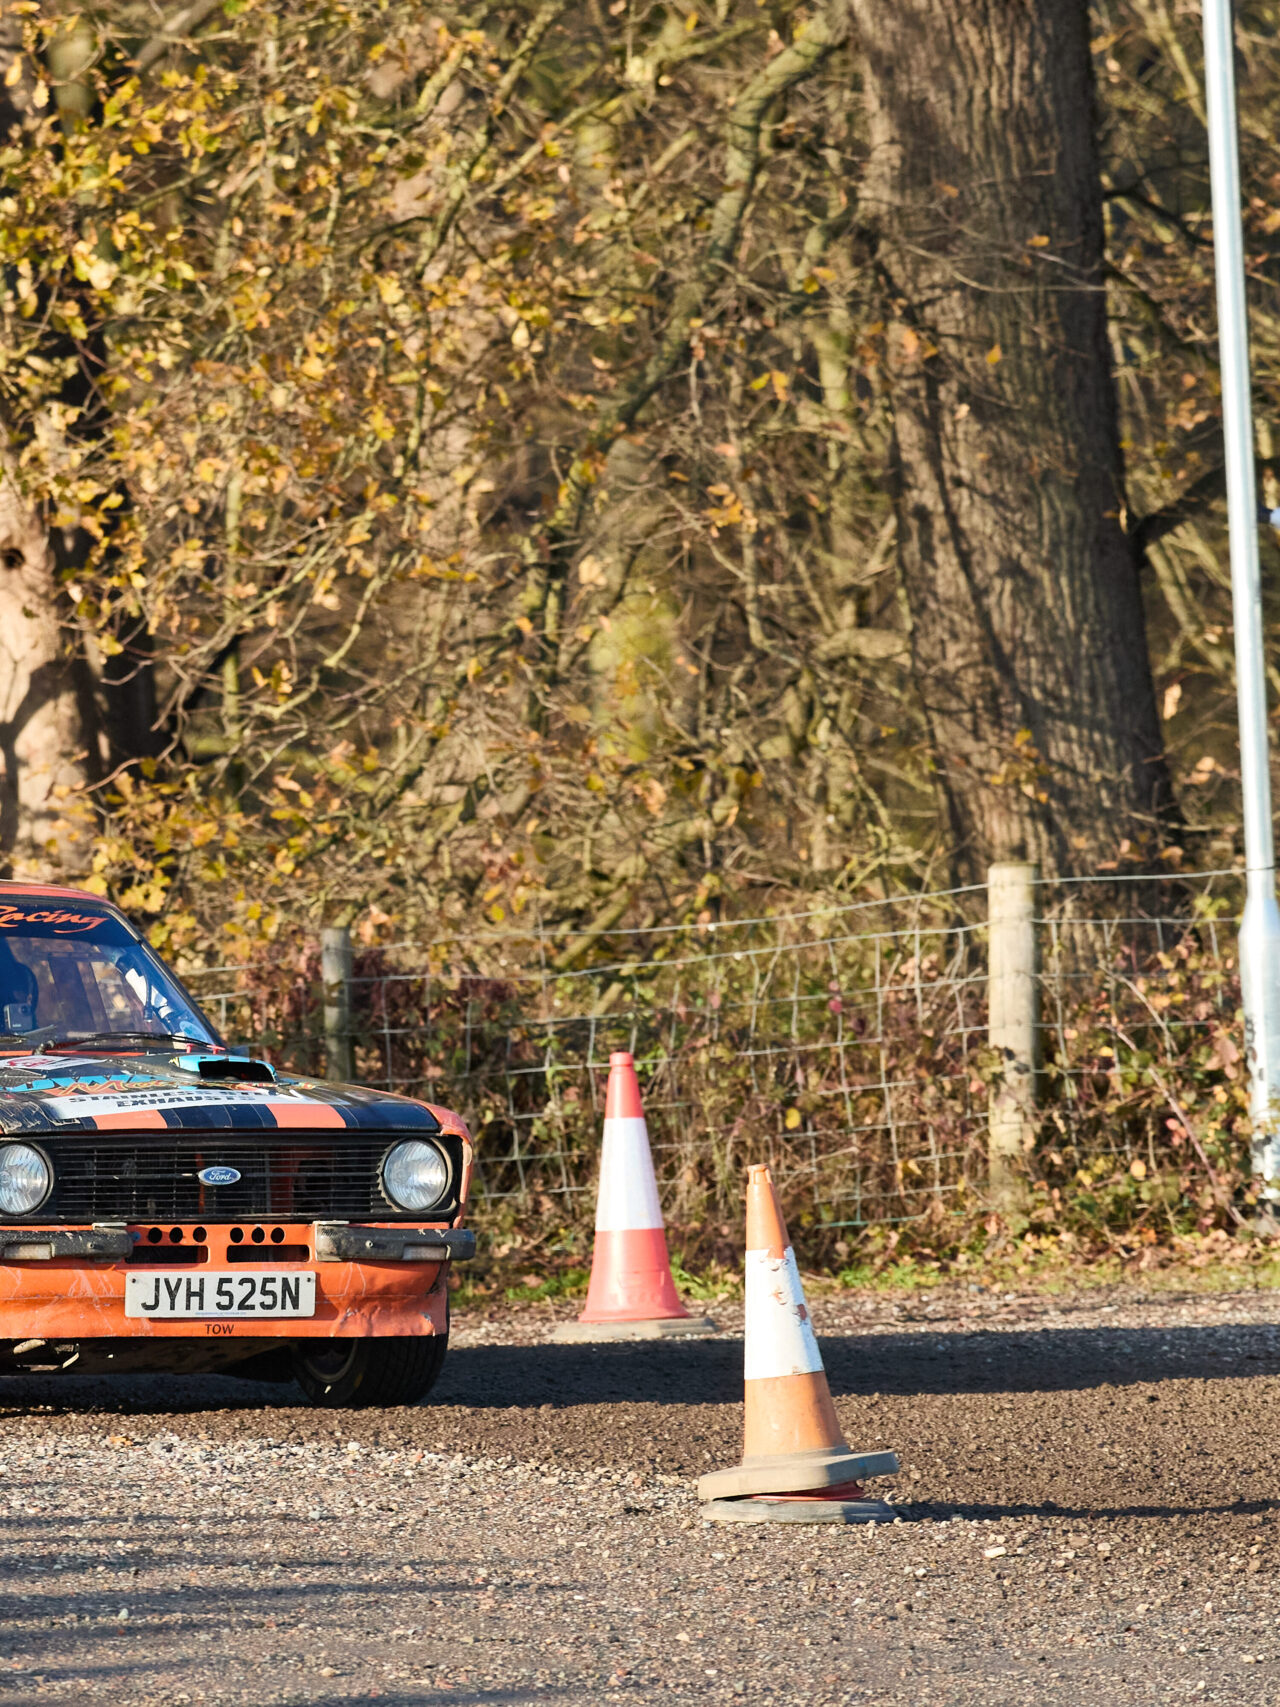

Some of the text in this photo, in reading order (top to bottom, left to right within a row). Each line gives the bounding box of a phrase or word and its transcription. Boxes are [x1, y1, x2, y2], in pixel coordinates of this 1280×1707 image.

[208, 1169, 233, 1181] Ford
[140, 1277, 300, 1311] JYH 525N
[205, 1324, 235, 1335] TOW
